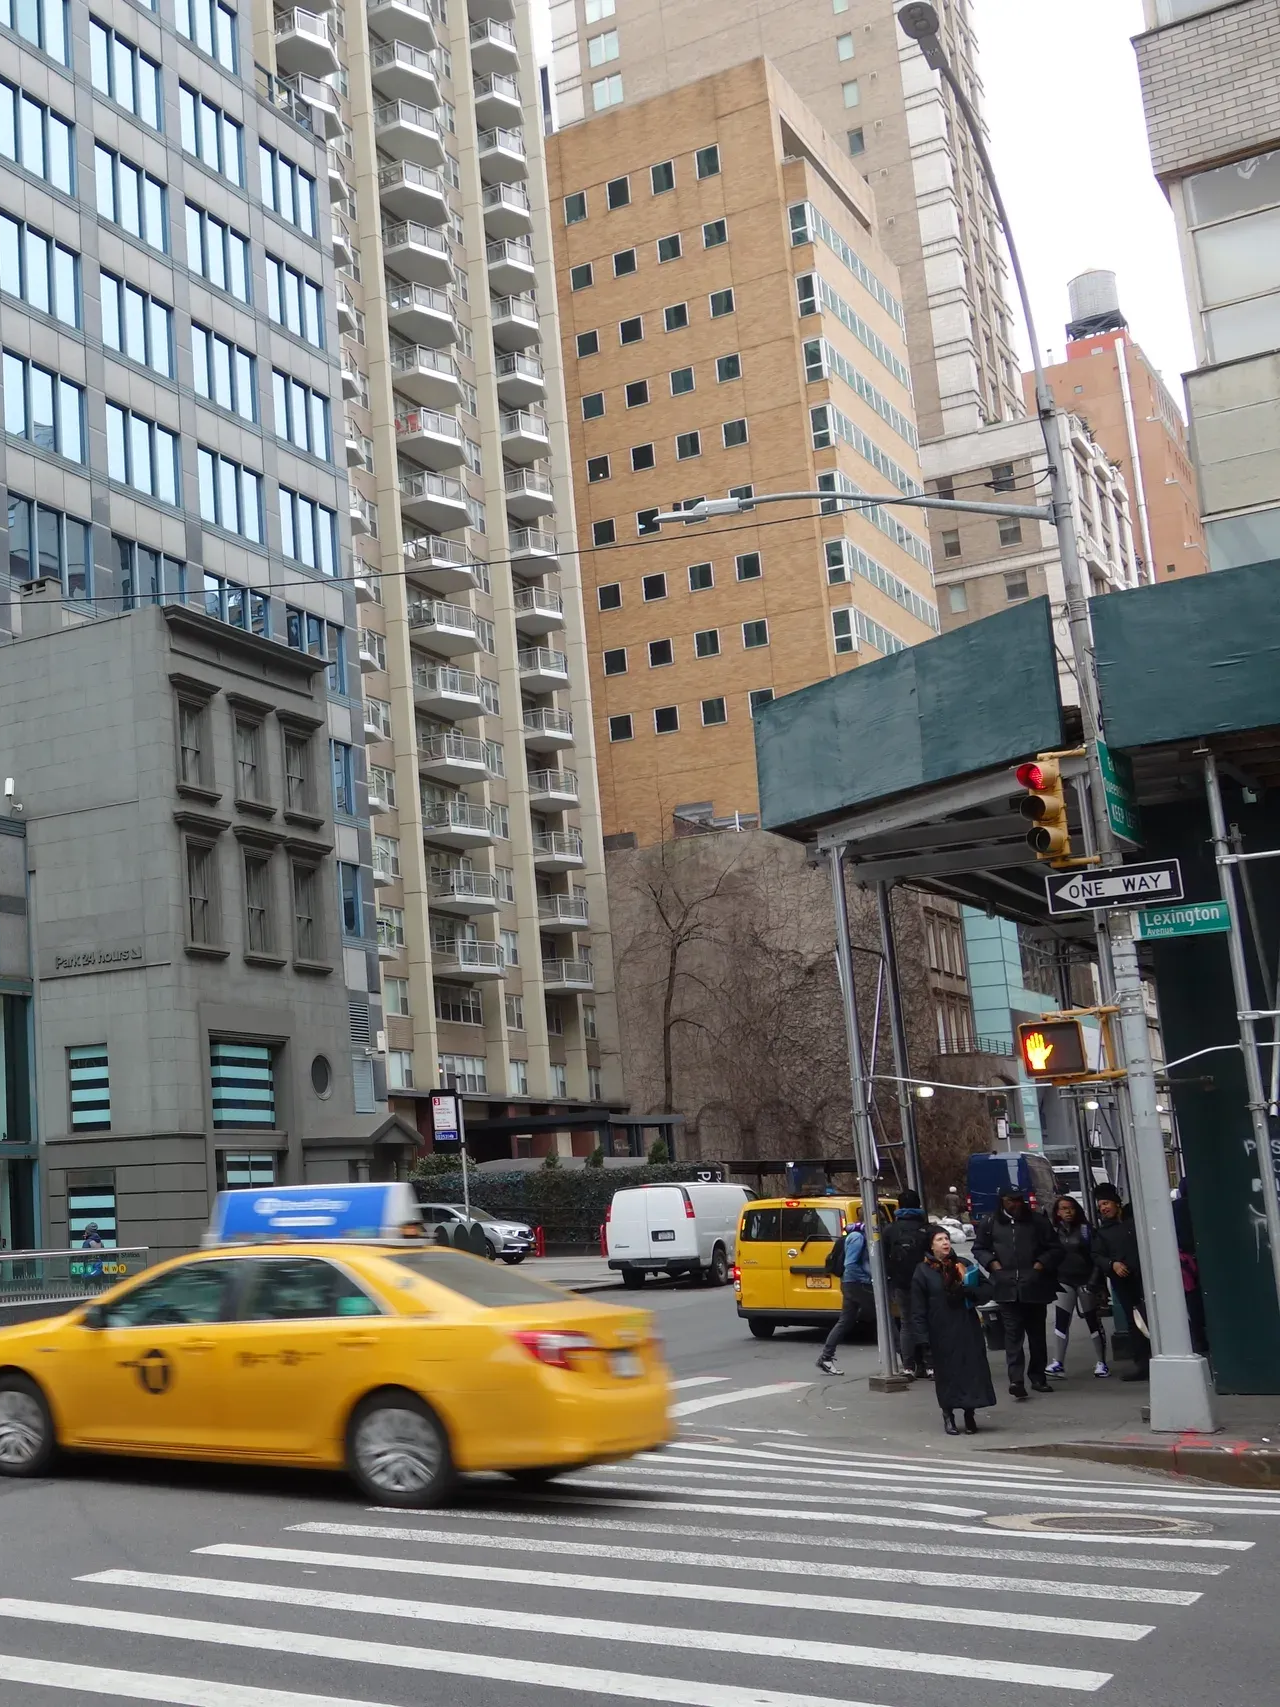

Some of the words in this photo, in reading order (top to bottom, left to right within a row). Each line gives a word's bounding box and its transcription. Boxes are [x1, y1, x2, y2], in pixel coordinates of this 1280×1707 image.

[1111, 803, 1124, 824] KEEP
[1068, 881, 1105, 900] ONE
[1122, 873, 1162, 892] WAY
[1144, 907, 1220, 927] Lexington
[1147, 927, 1174, 936] Avenue
[56, 955, 81, 969] Park
[83, 951, 96, 967] 24
[98, 948, 130, 964] hours
